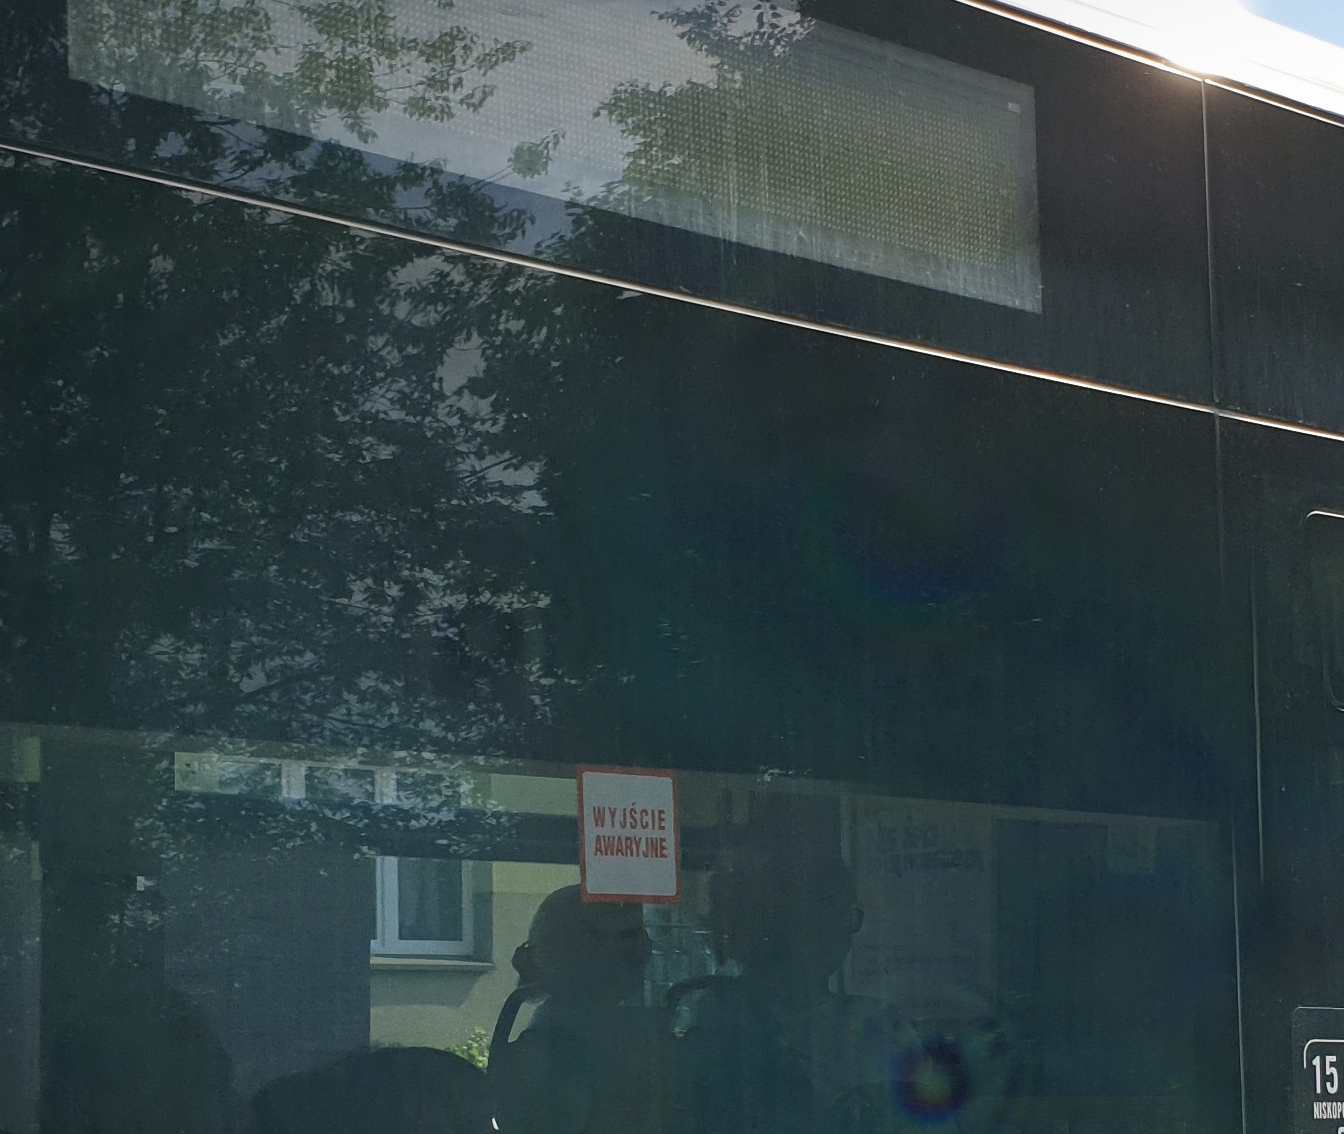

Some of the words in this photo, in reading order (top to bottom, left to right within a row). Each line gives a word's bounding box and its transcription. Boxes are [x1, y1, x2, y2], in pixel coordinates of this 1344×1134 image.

[592, 802, 666, 831] WYJŚCIE
[593, 834, 668, 858] AWARYJNE
[1311, 1055, 1338, 1095] 15
